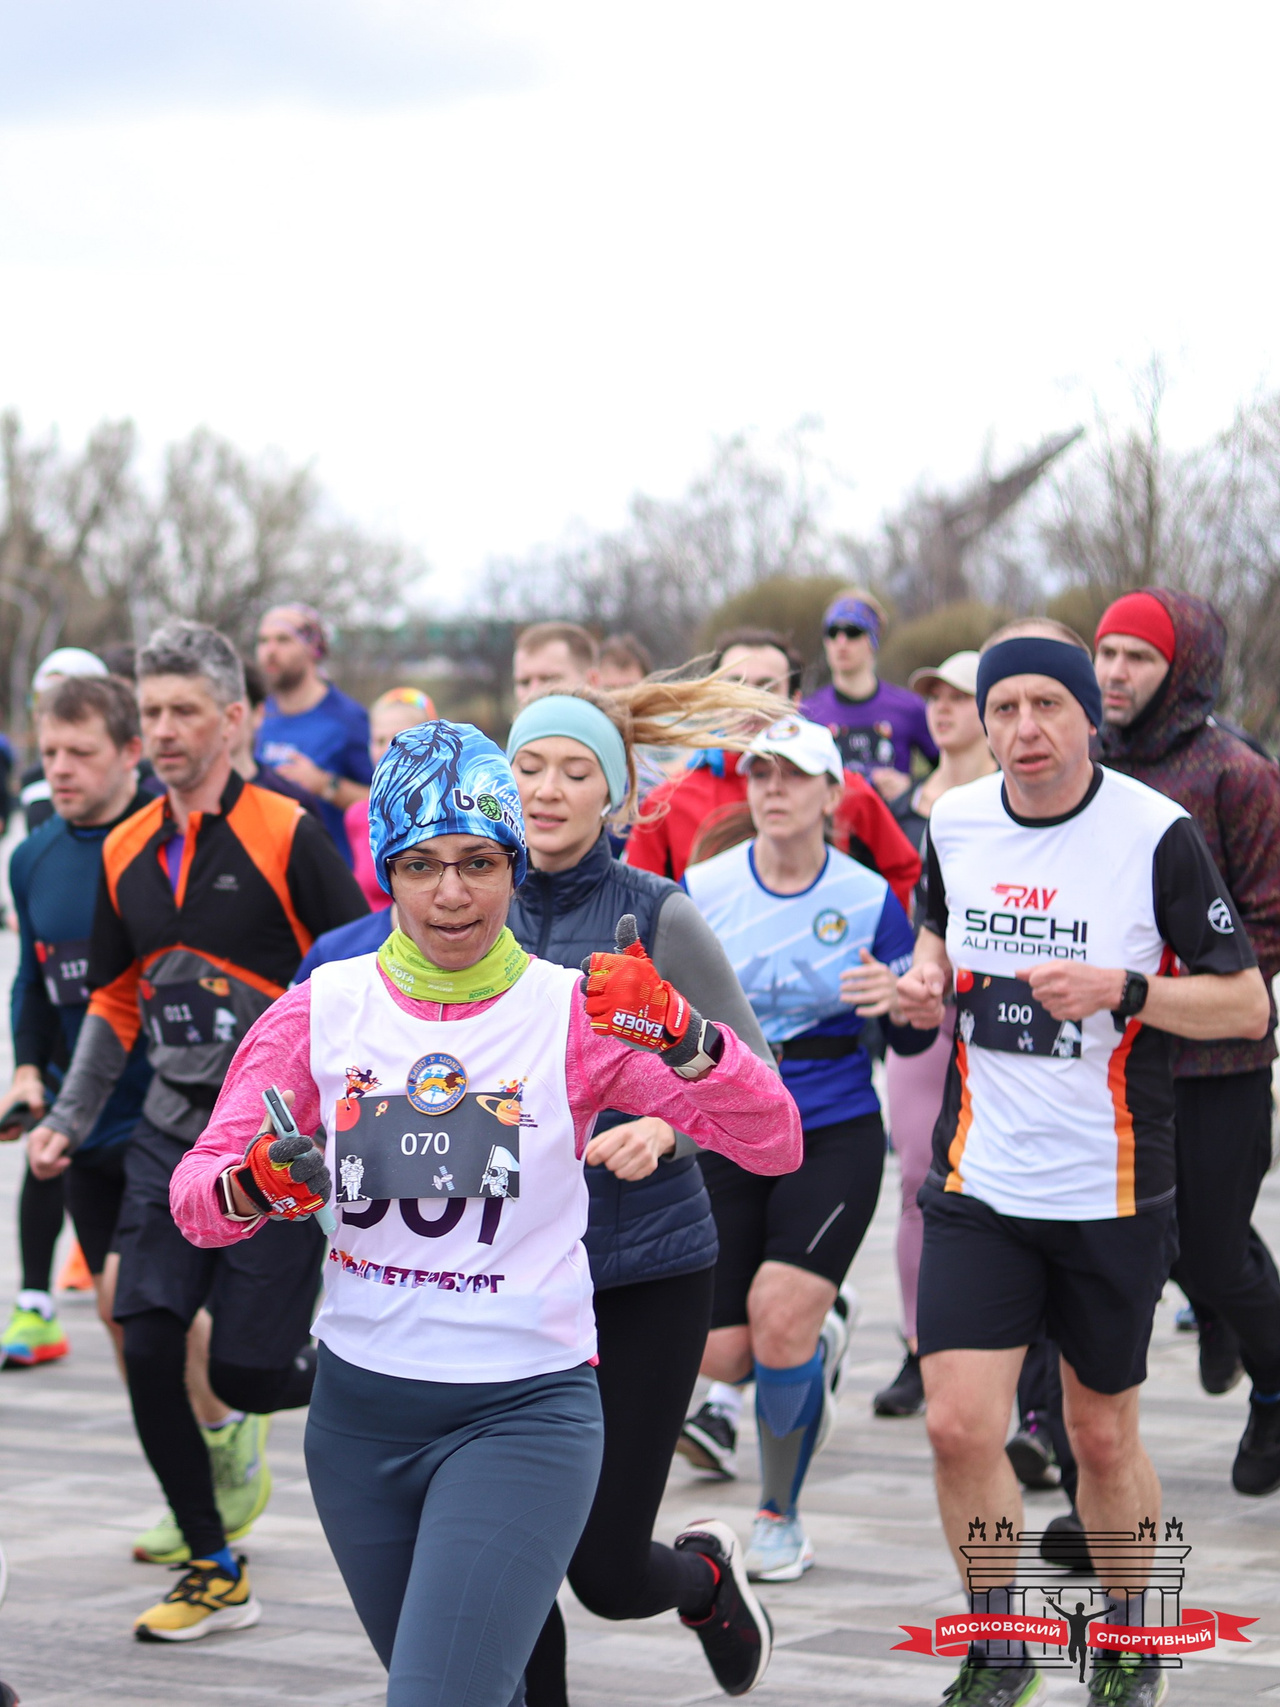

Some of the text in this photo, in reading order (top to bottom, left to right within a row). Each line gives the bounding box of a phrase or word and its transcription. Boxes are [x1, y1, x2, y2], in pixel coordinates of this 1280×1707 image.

[964, 908, 1088, 944] SOCHI
[962, 936, 1087, 961] AUTODROM
[60, 958, 88, 980] 117
[163, 1003, 193, 1023] 011
[612, 1011, 664, 1039] EADER
[997, 1002, 1033, 1026] 100
[400, 1131, 451, 1156] 070
